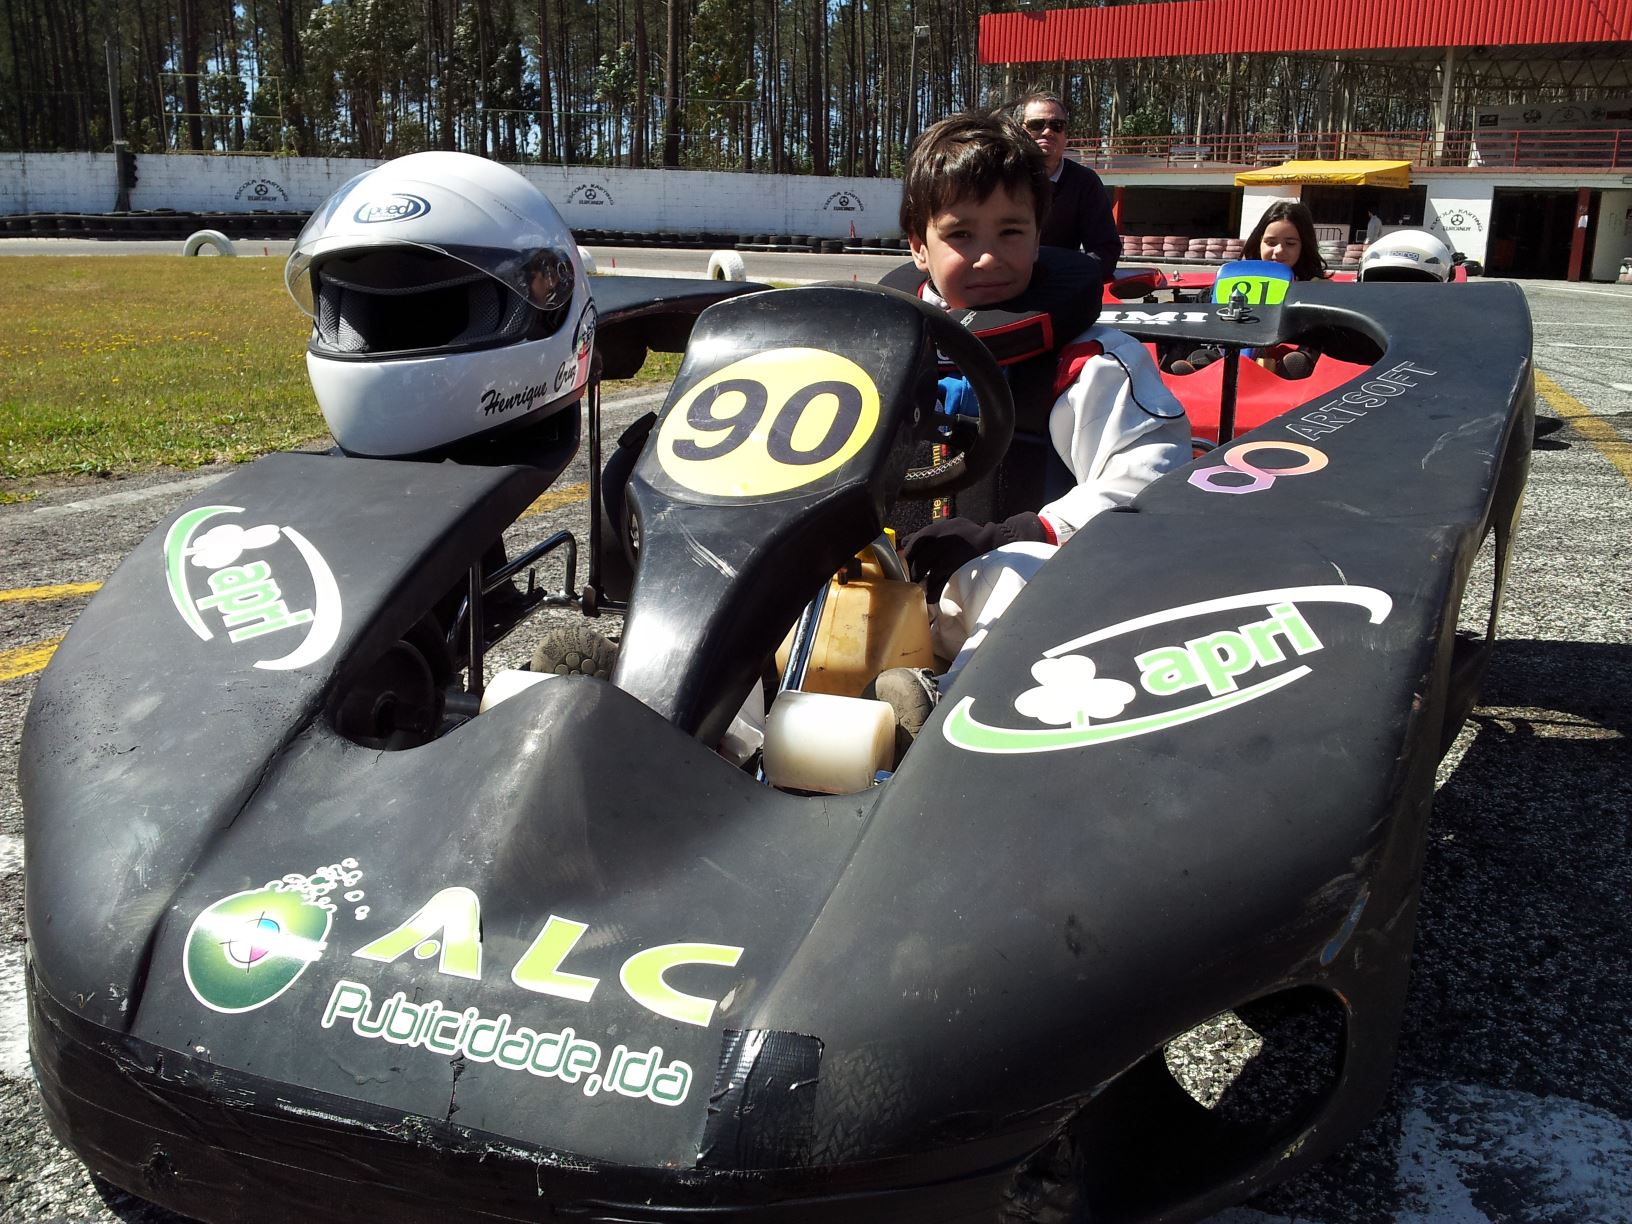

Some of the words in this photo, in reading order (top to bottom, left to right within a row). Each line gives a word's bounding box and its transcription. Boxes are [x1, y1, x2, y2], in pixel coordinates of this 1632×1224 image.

[480, 382, 548, 416] Henrique
[672, 378, 863, 466] 90
[1286, 361, 1438, 442] ARTSOFT
[195, 560, 316, 644] apri
[1134, 601, 1325, 697] apri
[352, 886, 745, 1028] ALC
